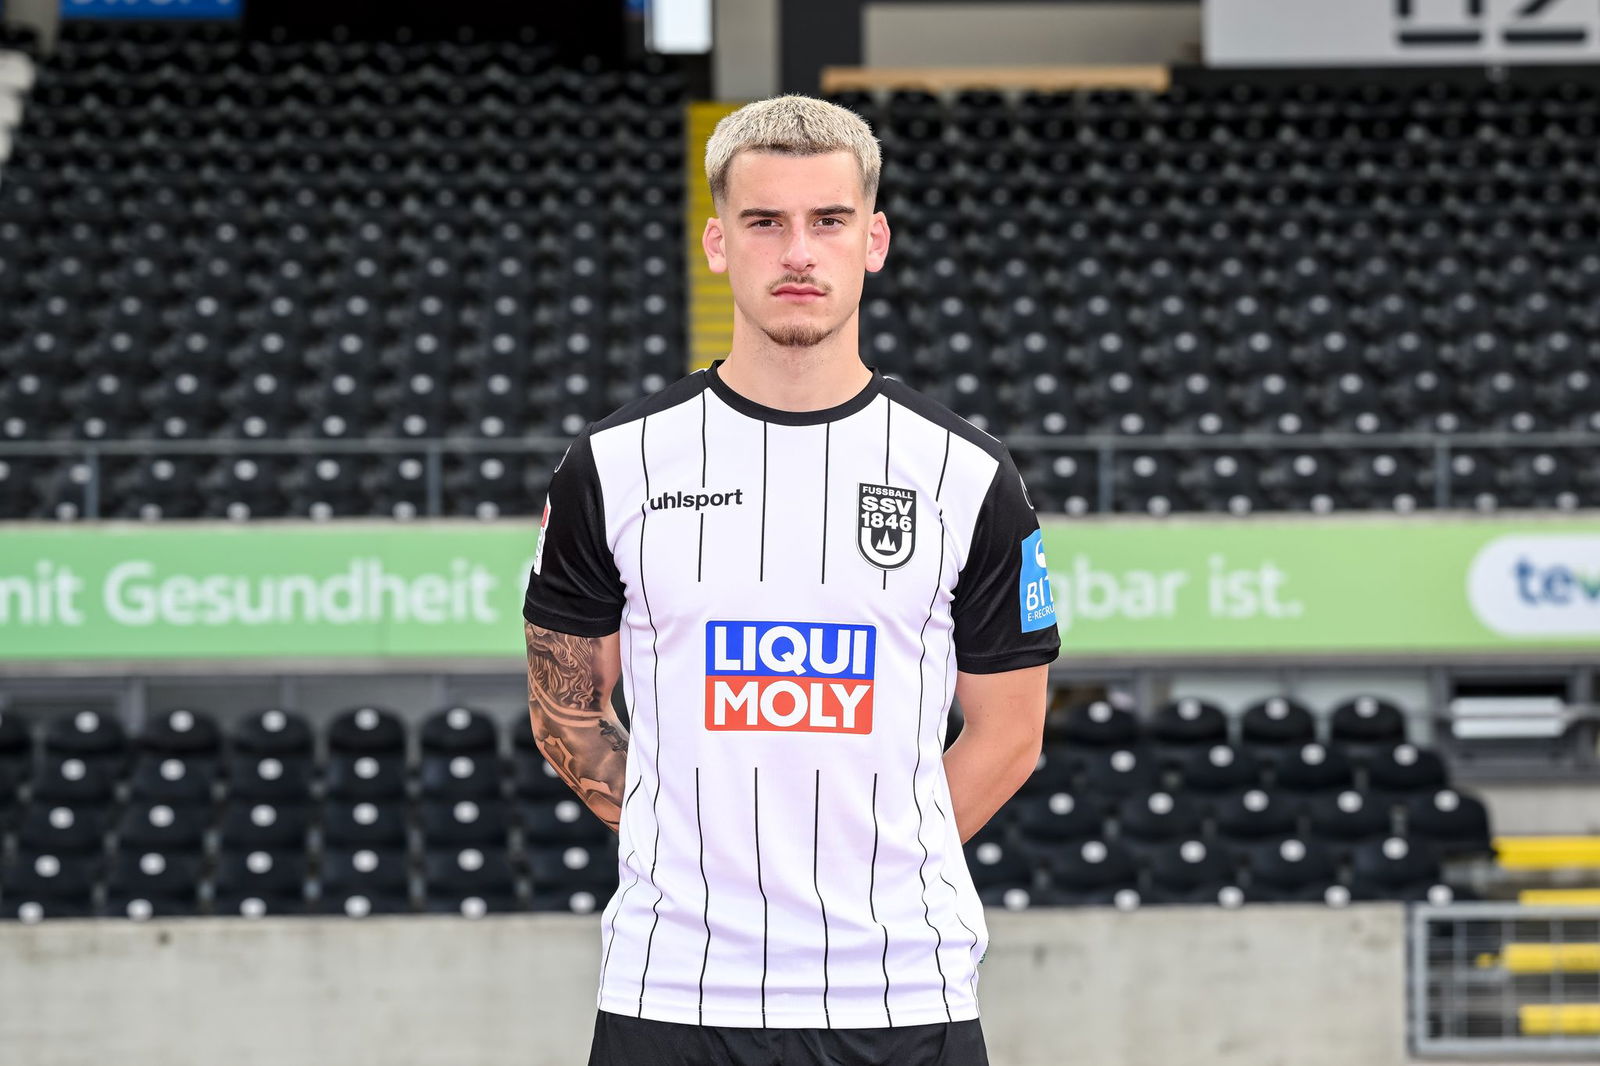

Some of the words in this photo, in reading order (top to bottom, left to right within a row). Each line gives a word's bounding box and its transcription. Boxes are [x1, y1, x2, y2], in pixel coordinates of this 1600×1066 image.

[650, 489, 743, 511] uhlsport
[861, 496, 913, 516] SSV
[862, 485, 914, 500] FUSSBALL
[861, 511, 912, 532] 1846
[103, 558, 497, 626] Gesundheit
[1207, 555, 1304, 618] ist.
[714, 625, 868, 676] LIQUI
[714, 680, 871, 728] MOLY
